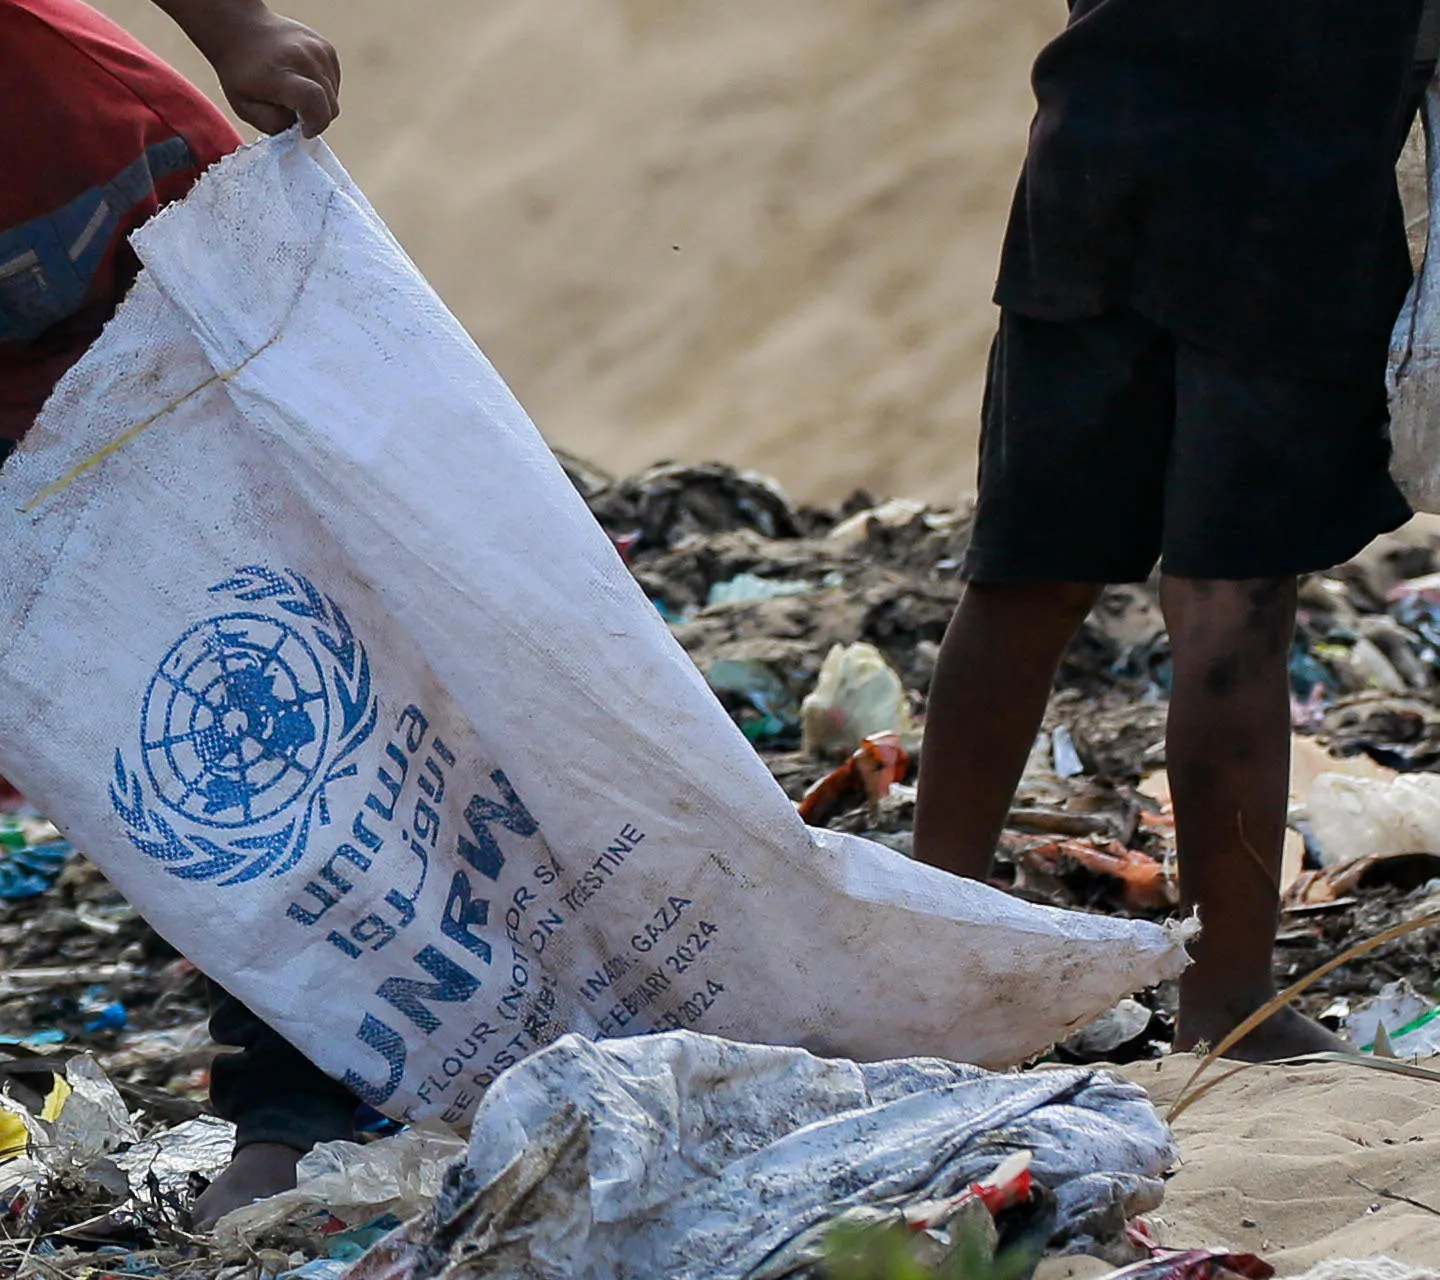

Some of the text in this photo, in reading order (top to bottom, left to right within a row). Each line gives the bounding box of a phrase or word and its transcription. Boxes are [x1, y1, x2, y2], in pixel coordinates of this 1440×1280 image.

[286, 703, 429, 926] unrwa
[341, 768, 540, 1106] UNRW
[505, 885, 537, 946] FOR
[630, 895, 693, 953] GAZA
[666, 919, 719, 974] 2024
[496, 945, 530, 1021] (NOT
[678, 978, 725, 1023] 2024
[417, 1021, 499, 1105] FLOUR
